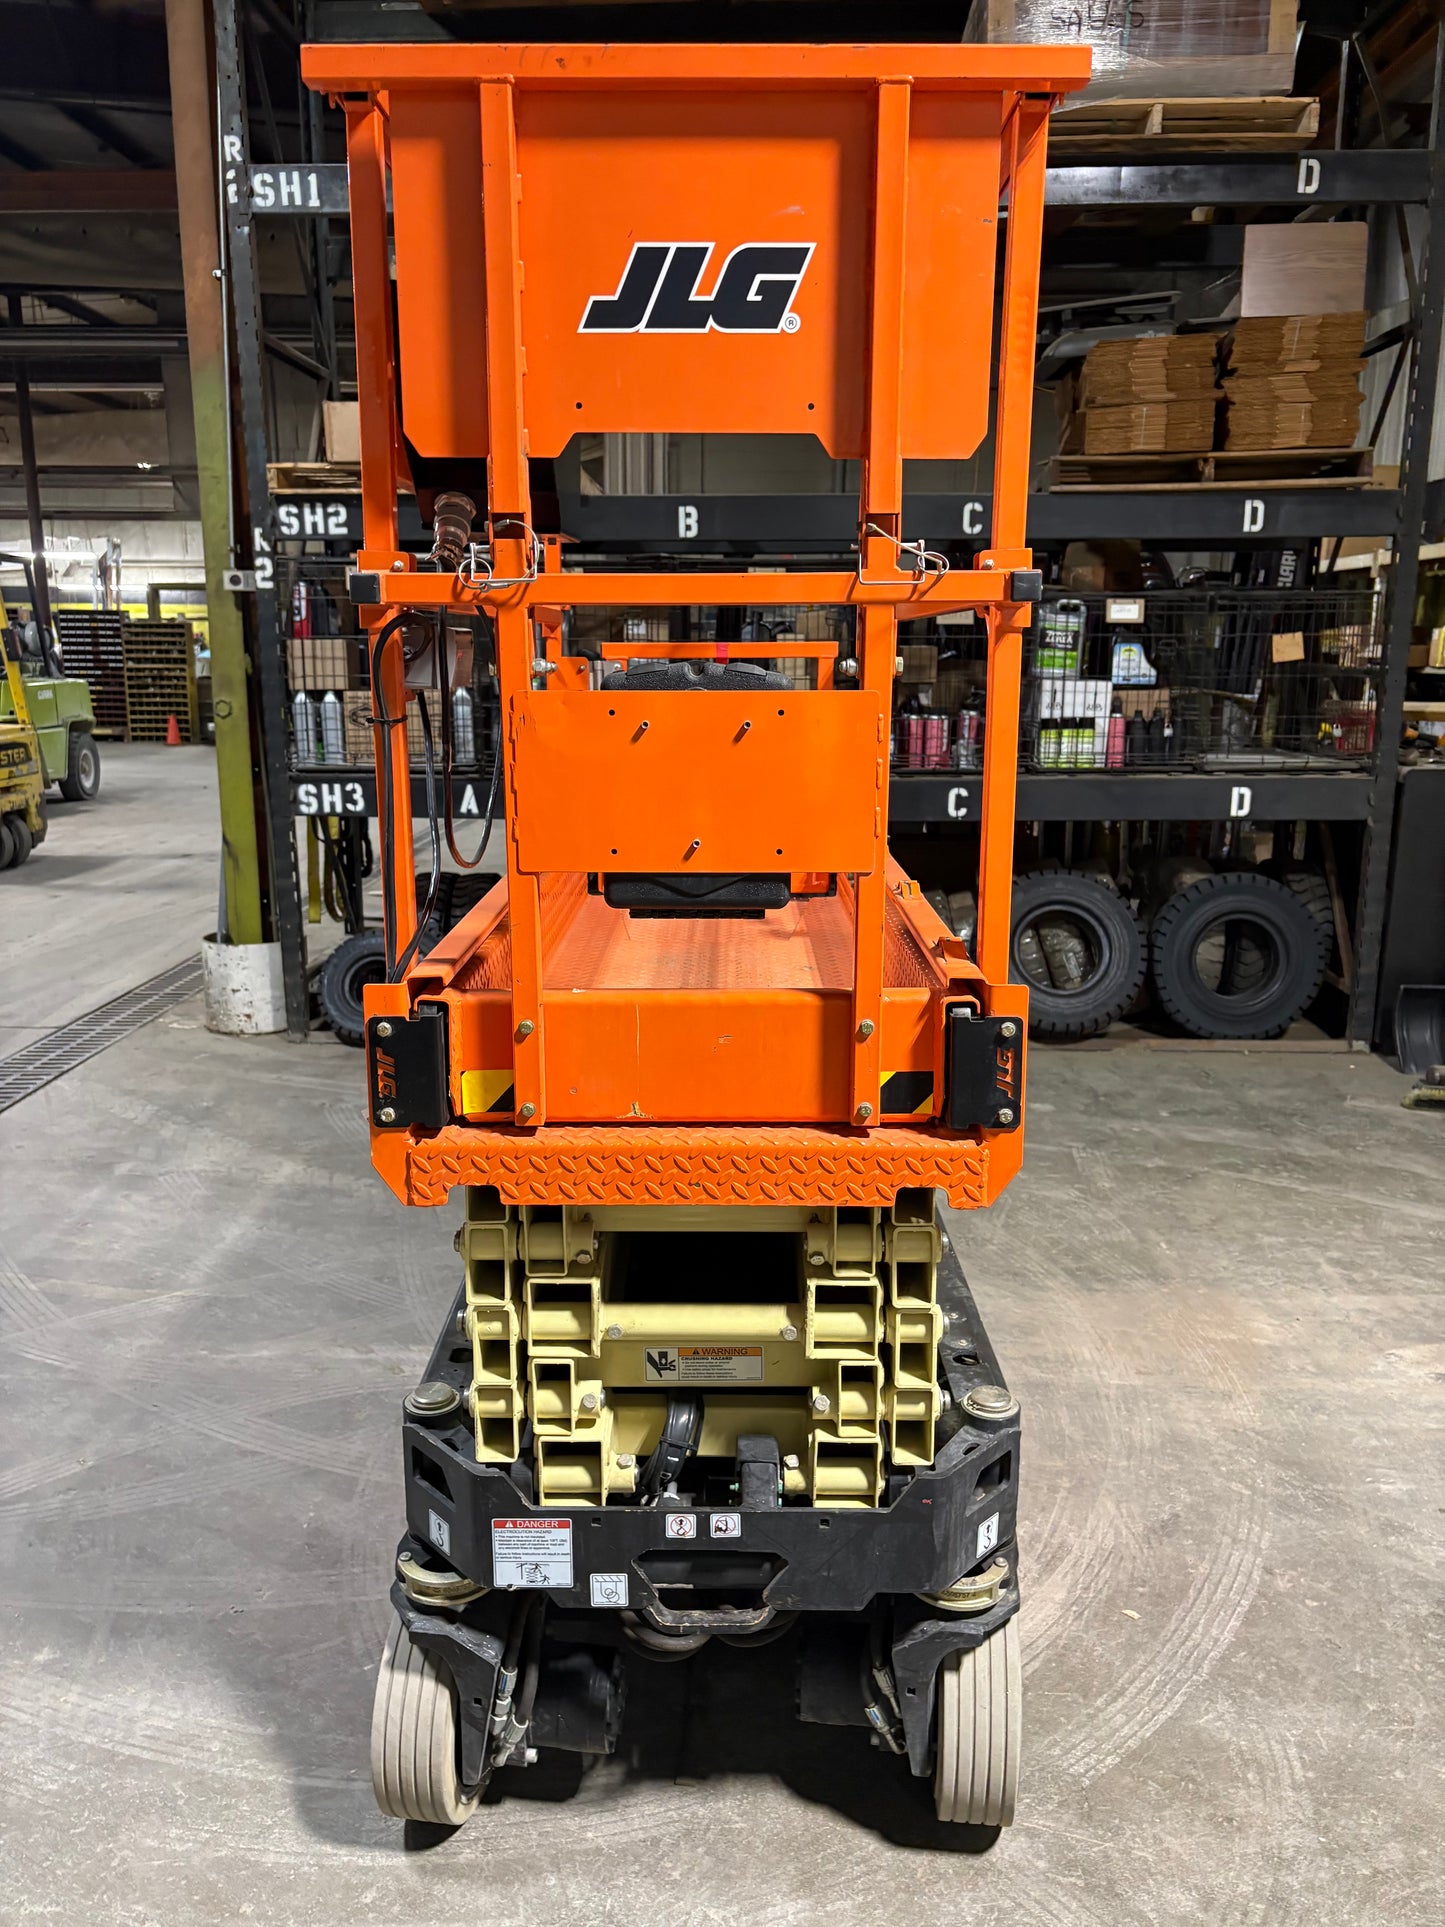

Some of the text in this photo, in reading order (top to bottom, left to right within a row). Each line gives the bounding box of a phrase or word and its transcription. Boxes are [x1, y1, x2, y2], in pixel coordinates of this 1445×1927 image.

[253, 171, 321, 207] SH1
[1297, 158, 1321, 194] D
[577, 242, 817, 333] JLG
[278, 502, 349, 536] SH2
[678, 505, 699, 539] B
[962, 501, 984, 535] C
[1243, 499, 1265, 533] D
[297, 782, 365, 815] SH3
[459, 783, 480, 815] A
[948, 787, 968, 818] C
[1230, 786, 1252, 818] D
[376, 1047, 396, 1098] JLG
[996, 1047, 1015, 1099] JLG
[516, 1520, 559, 1528] DANGER
